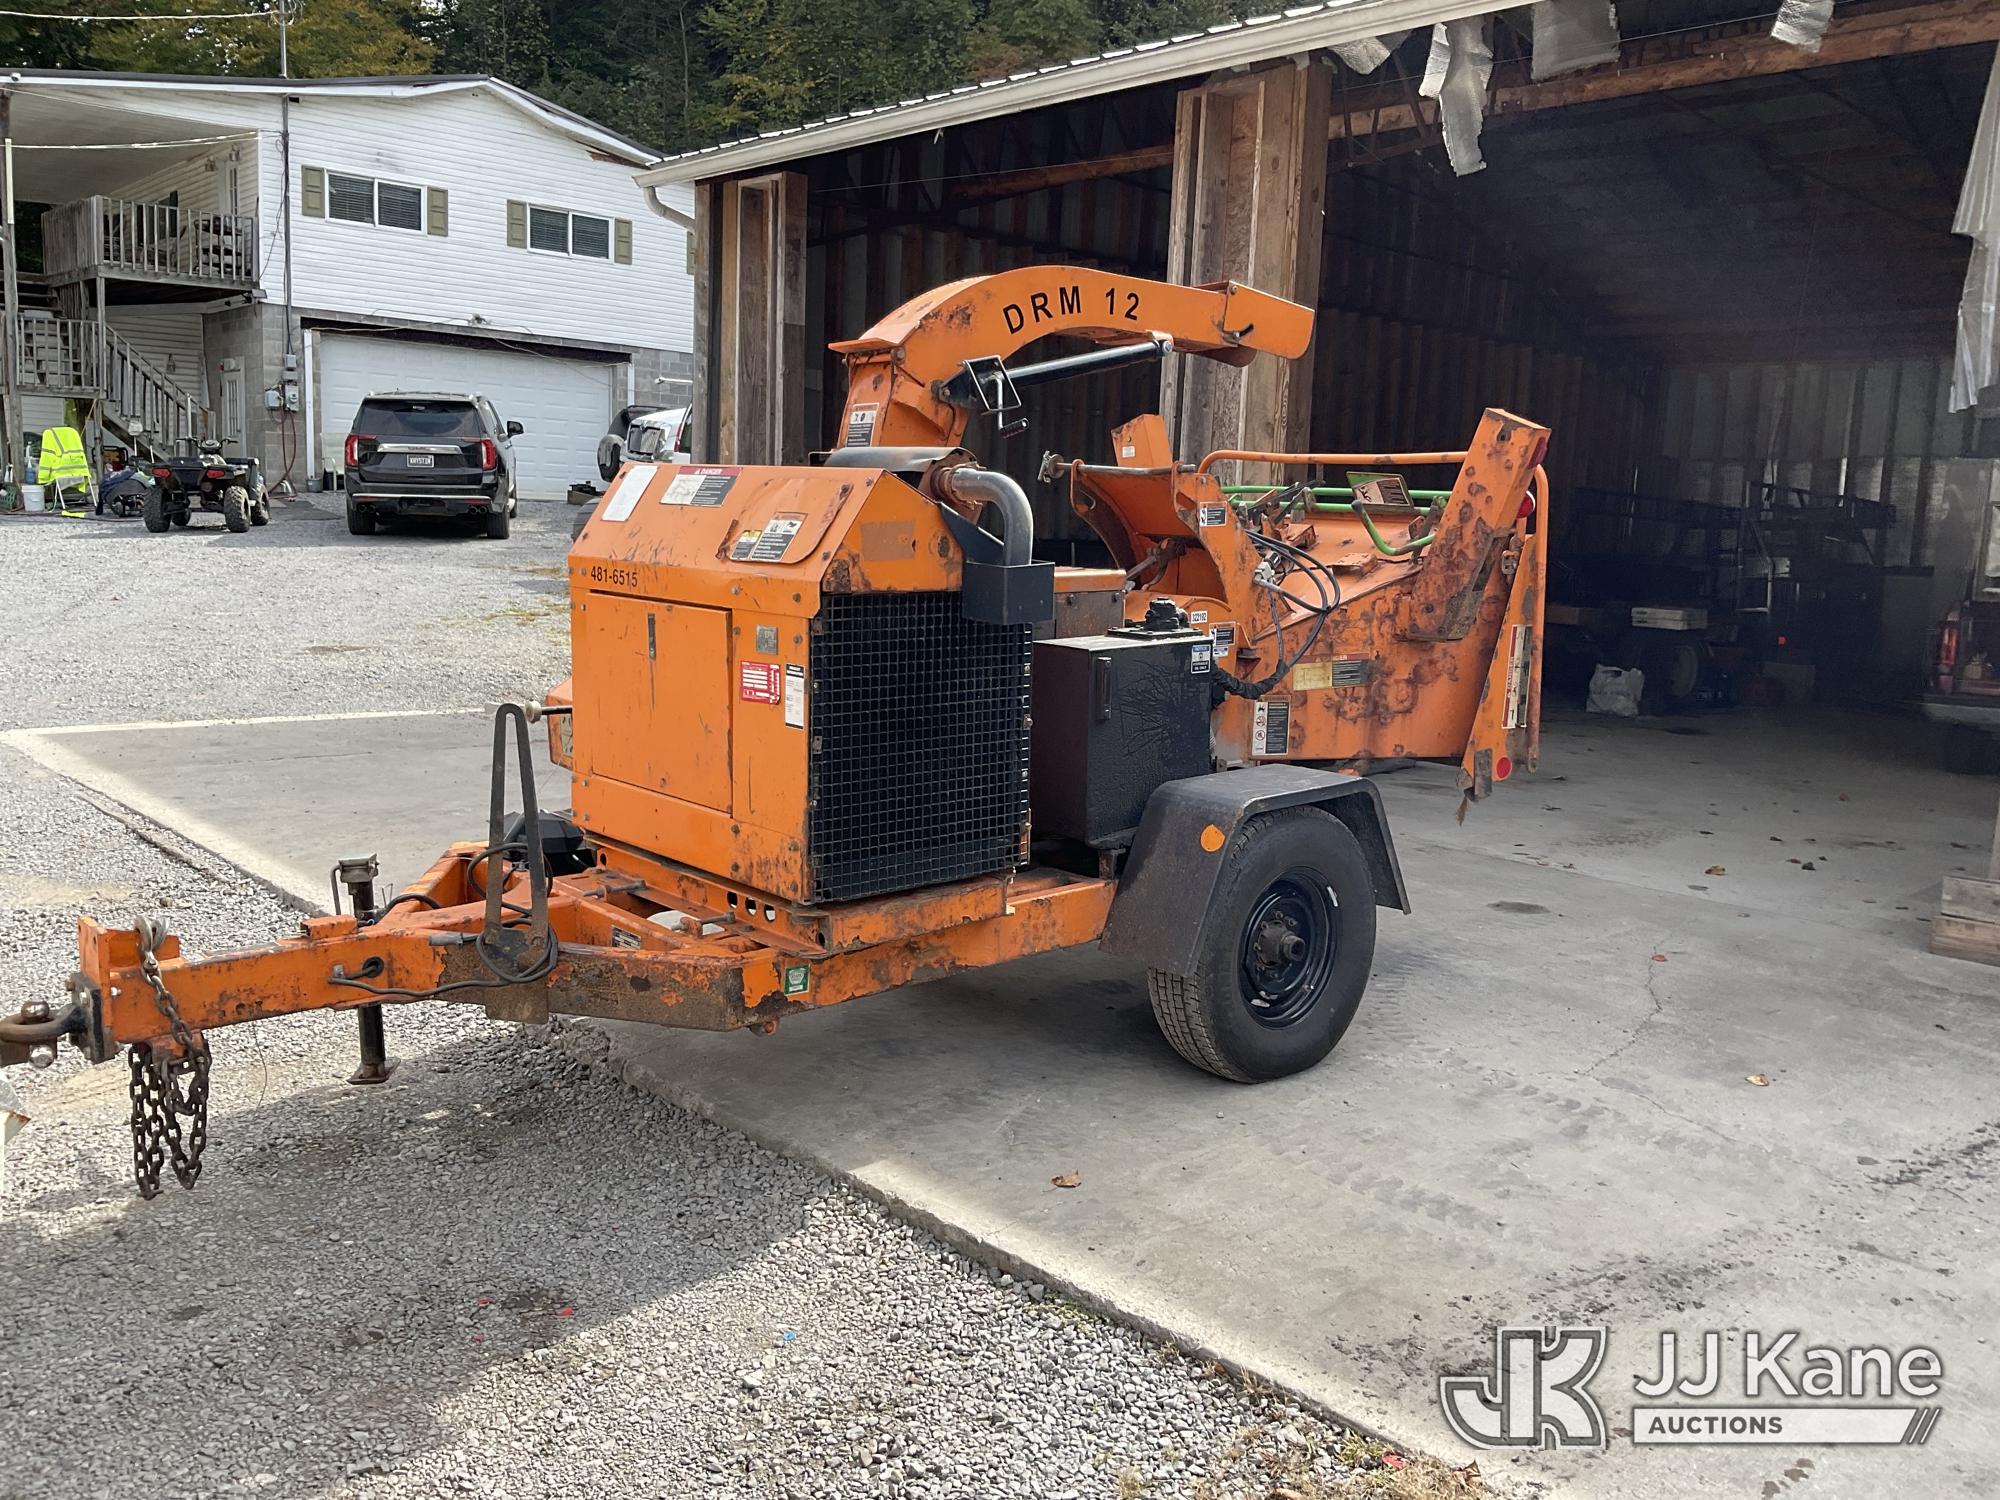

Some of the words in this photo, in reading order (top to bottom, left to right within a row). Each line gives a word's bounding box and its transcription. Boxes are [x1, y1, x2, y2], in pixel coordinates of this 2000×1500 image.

[1003, 286, 1081, 335] DRM
[1105, 288, 1139, 320] 12
[591, 566, 638, 588] 481-6515
